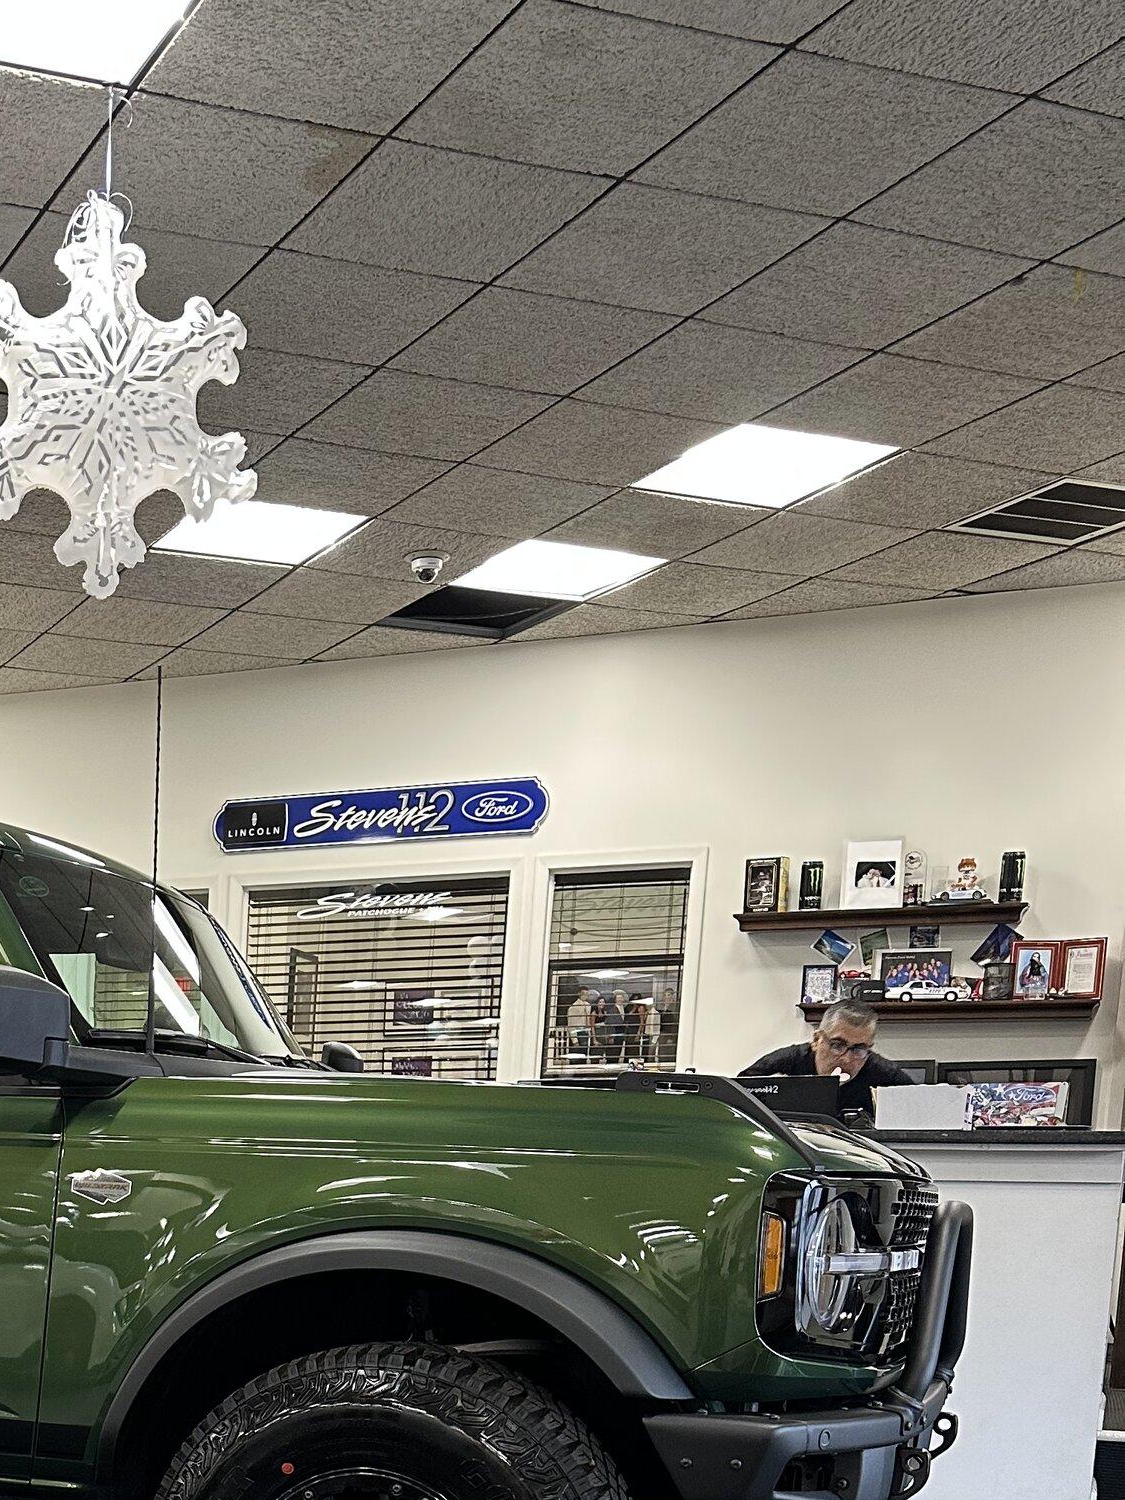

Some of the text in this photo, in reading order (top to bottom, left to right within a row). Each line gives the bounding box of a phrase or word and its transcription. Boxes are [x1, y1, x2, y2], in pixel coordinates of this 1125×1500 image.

[293, 788, 455, 838] Stevens 112
[474, 797, 519, 817] Ford
[227, 826, 281, 838] LINCOLN
[296, 892, 453, 919] Stevens
[347, 907, 416, 917] PATCHOGUE
[1013, 1086, 1053, 1103] Ford
